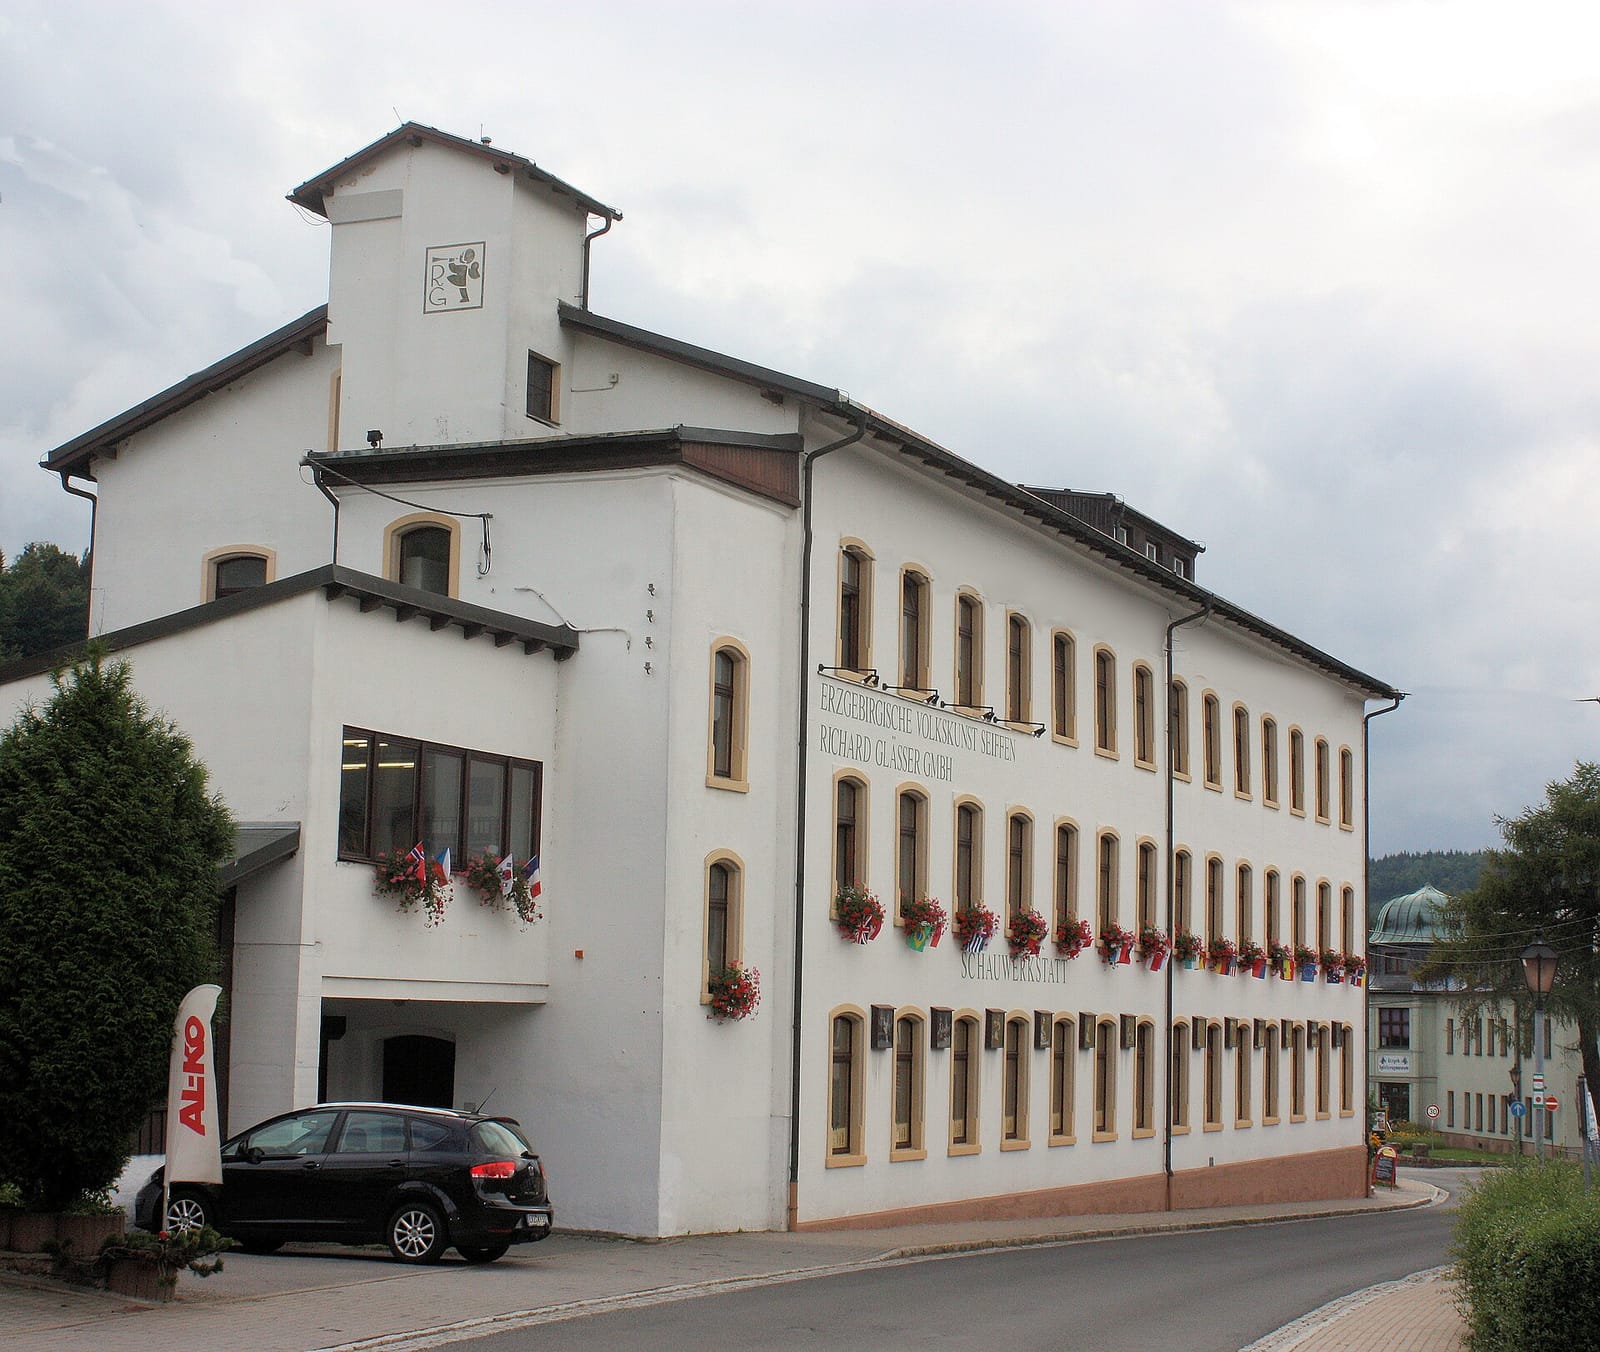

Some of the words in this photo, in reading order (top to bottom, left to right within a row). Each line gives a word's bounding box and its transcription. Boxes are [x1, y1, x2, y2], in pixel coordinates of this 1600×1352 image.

[429, 286, 446, 306] G
[431, 264, 444, 287] R
[821, 683, 912, 734] ERZGEBIRGISCHE
[916, 711, 978, 751] VOLKSKUNST
[981, 730, 1016, 762] SEIFFEN
[820, 724, 871, 763] RICHARD
[875, 736, 920, 774] GLÄSSER
[923, 752, 952, 782] GMBH
[961, 951, 1068, 983] SCHAUWERKSTATT
[179, 1015, 206, 1136] AL-KO
